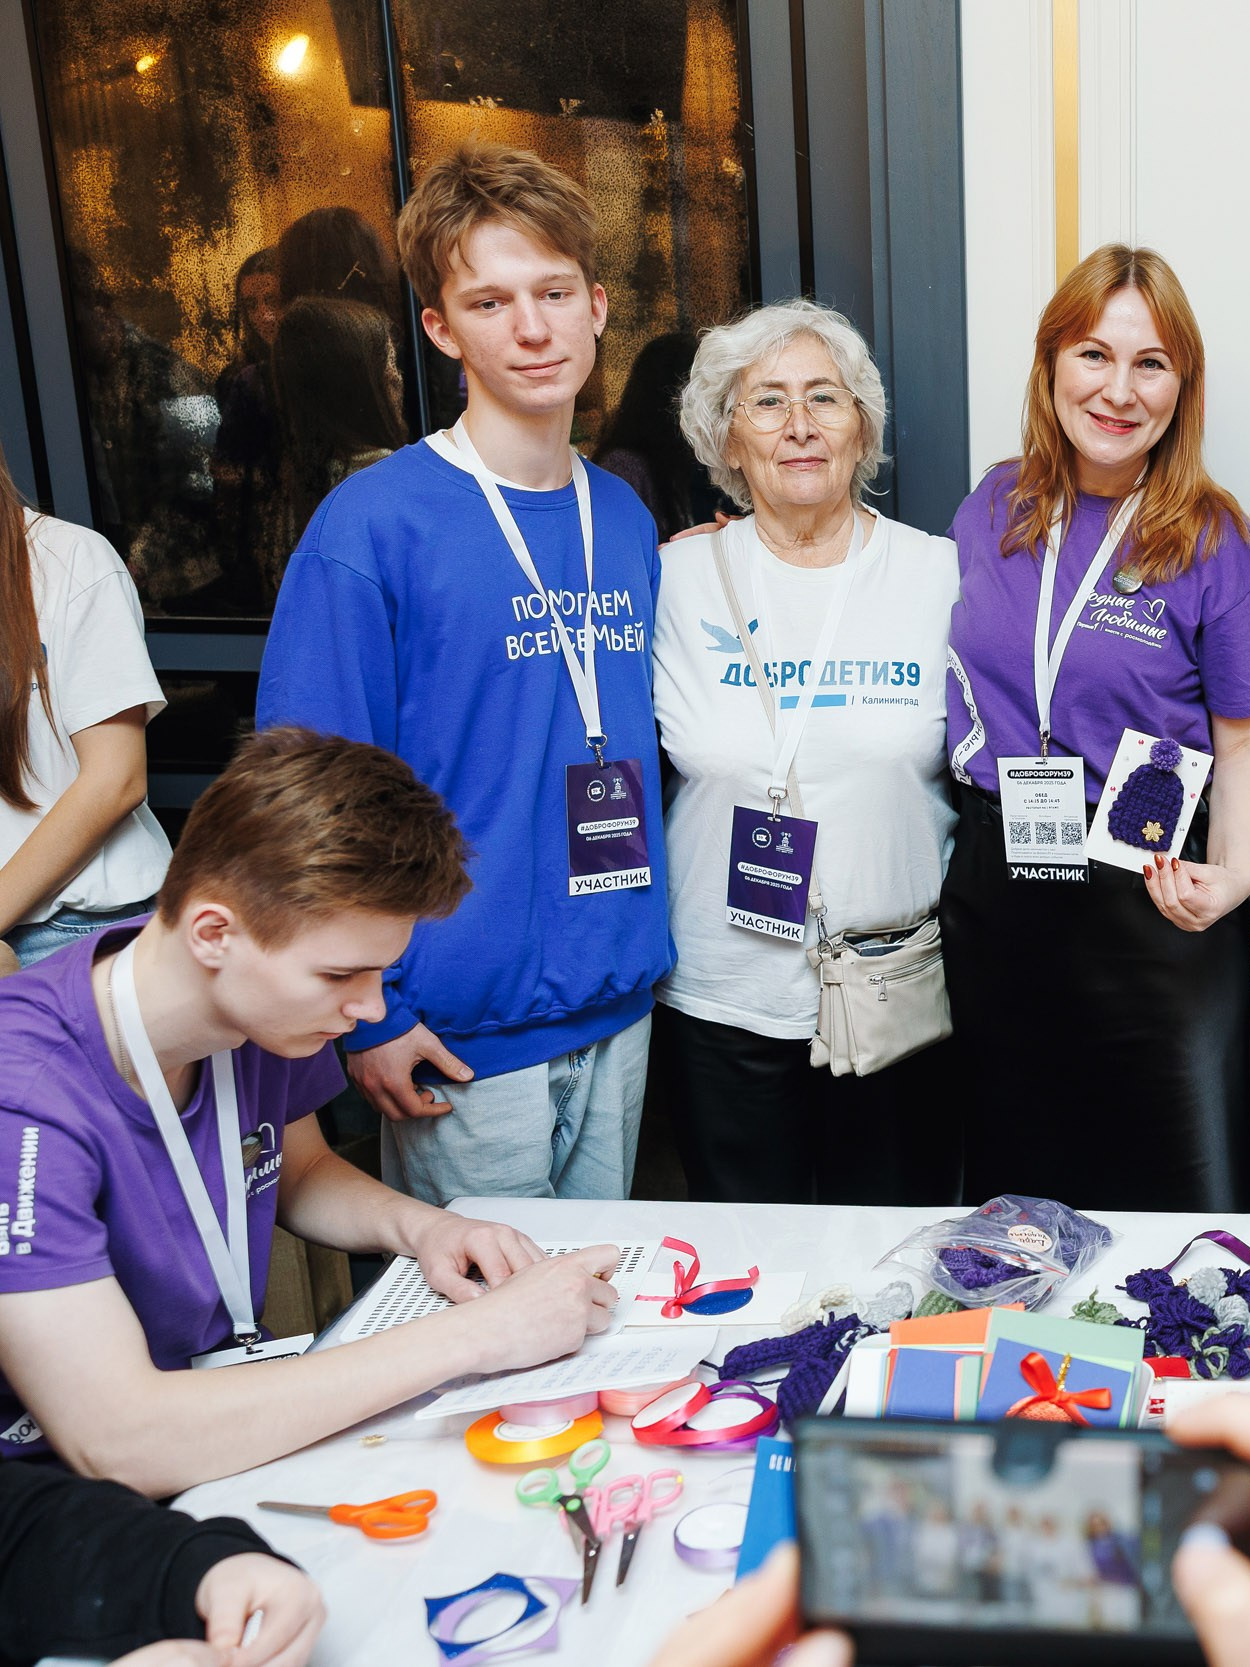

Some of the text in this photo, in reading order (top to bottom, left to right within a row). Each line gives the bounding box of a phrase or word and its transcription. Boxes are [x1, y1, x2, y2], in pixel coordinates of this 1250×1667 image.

[862, 696, 919, 706] Калининград
[575, 872, 648, 893] УЧАСТНИК
[1011, 867, 1085, 882] УЧАСТНИК
[730, 910, 801, 939] УЧАСТНИК
